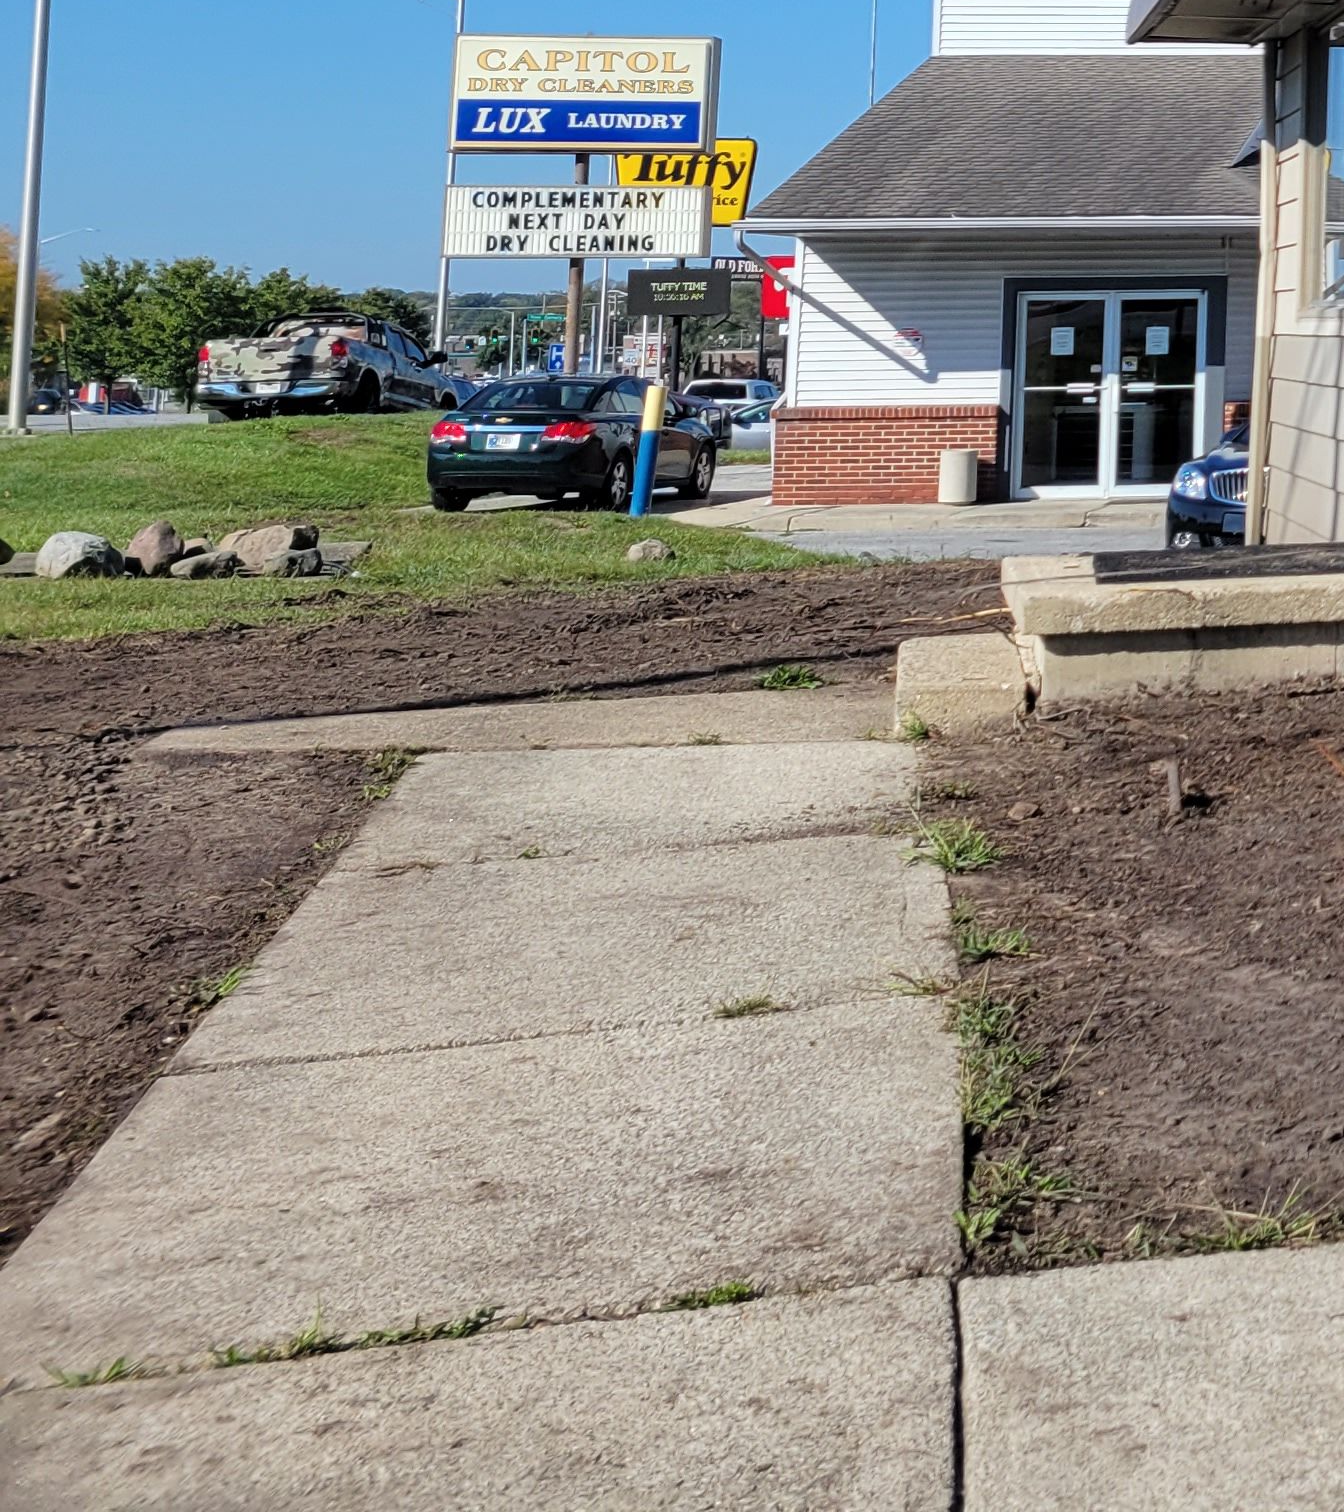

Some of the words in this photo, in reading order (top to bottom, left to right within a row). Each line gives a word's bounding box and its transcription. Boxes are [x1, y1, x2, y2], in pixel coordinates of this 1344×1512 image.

[477, 49, 690, 73] CAPITOL
[467, 78, 528, 92] DRY
[538, 78, 694, 94] CLEANERS
[472, 108, 551, 133] LUX
[567, 113, 686, 129] LAUNDRY
[623, 152, 746, 190] Tuffy
[472, 191, 665, 208] COMPLEMENTARY
[508, 213, 563, 230] NEXT
[584, 213, 626, 229] DAY
[486, 235, 528, 252] DRY
[549, 235, 654, 251] CLEANING
[650, 282, 681, 291] TUFFY
[682, 282, 707, 290] TIME
